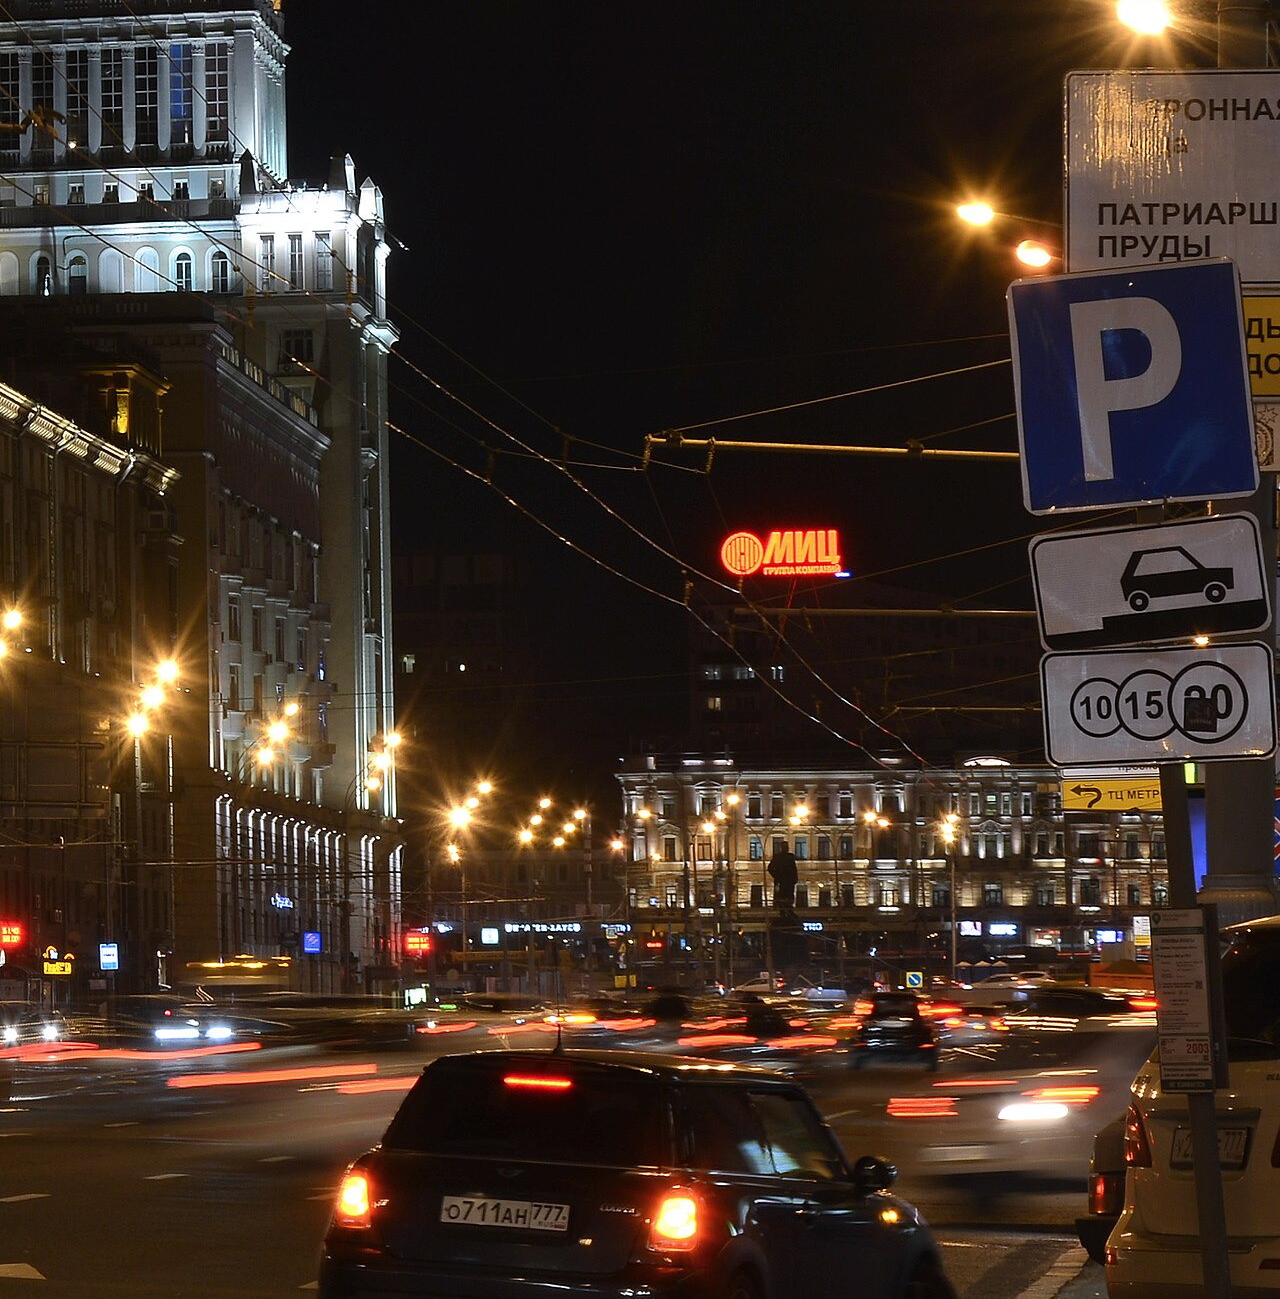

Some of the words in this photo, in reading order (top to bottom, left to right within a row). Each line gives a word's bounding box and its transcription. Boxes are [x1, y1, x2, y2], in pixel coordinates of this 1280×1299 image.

[1098, 203, 1277, 226] ПАТРИАРШ
[1098, 235, 1210, 262] ПРУДЫ
[762, 529, 841, 565] МИЦ
[1079, 695, 1113, 721] 10
[1124, 690, 1164, 720] 15
[1107, 790, 1124, 801] ТЦ
[1186, 1042, 1210, 1054] 2003
[533, 1203, 564, 1221] 777
